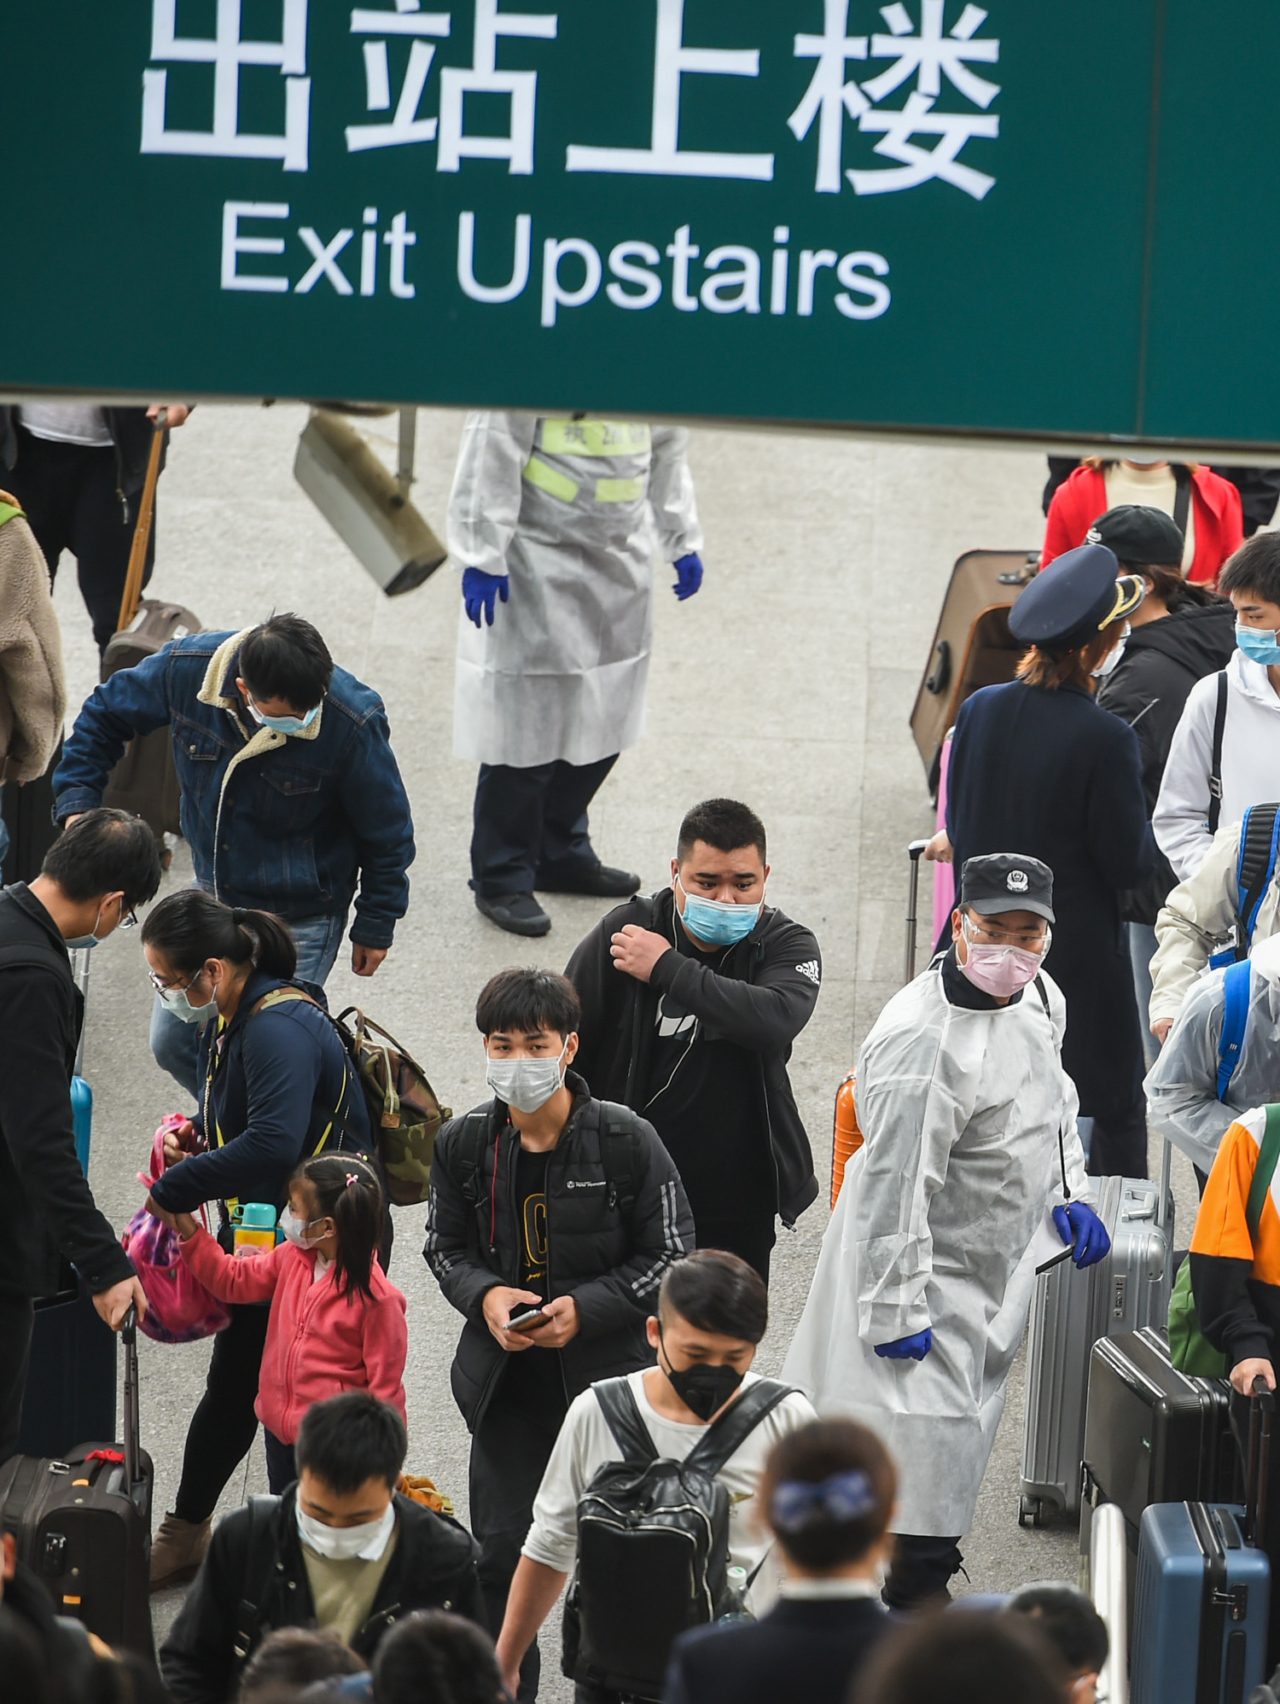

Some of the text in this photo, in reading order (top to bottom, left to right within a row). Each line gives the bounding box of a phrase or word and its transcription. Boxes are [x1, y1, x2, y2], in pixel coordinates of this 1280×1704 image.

[140, 0, 1000, 199] 出站上楼
[221, 200, 891, 327] Exit Upstairs
